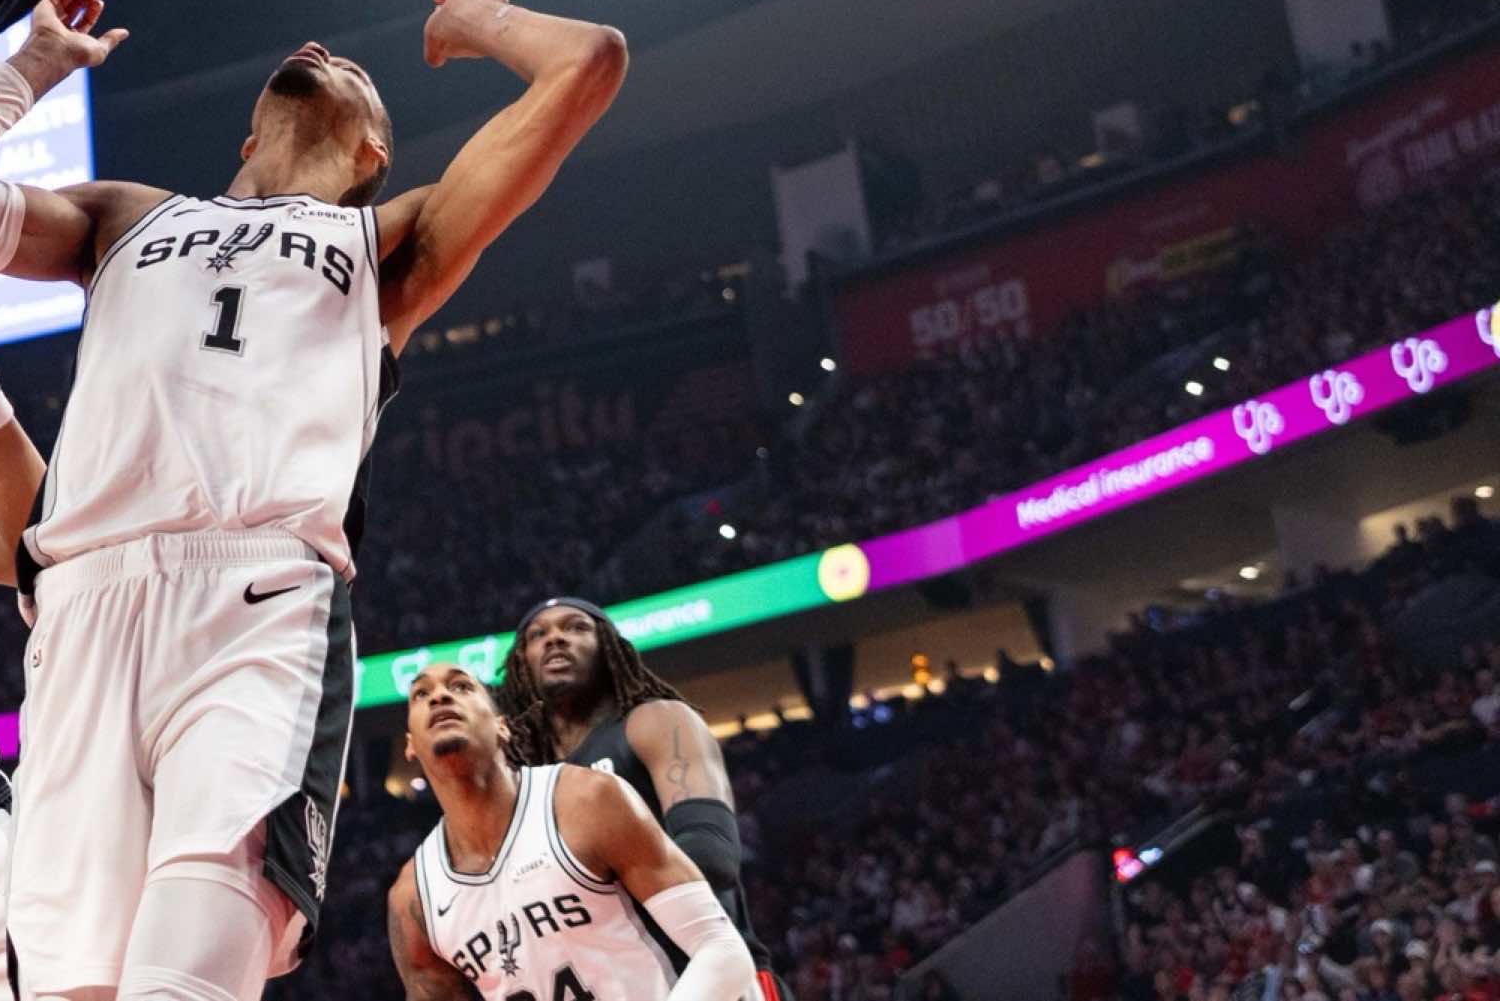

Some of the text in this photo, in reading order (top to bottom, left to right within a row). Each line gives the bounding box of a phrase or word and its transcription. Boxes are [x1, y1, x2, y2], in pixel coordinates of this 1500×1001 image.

[136, 223, 355, 296] SPURS
[200, 284, 245, 357] 1
[1015, 435, 1215, 529] Medical insurance
[453, 894, 592, 982] SPURS
